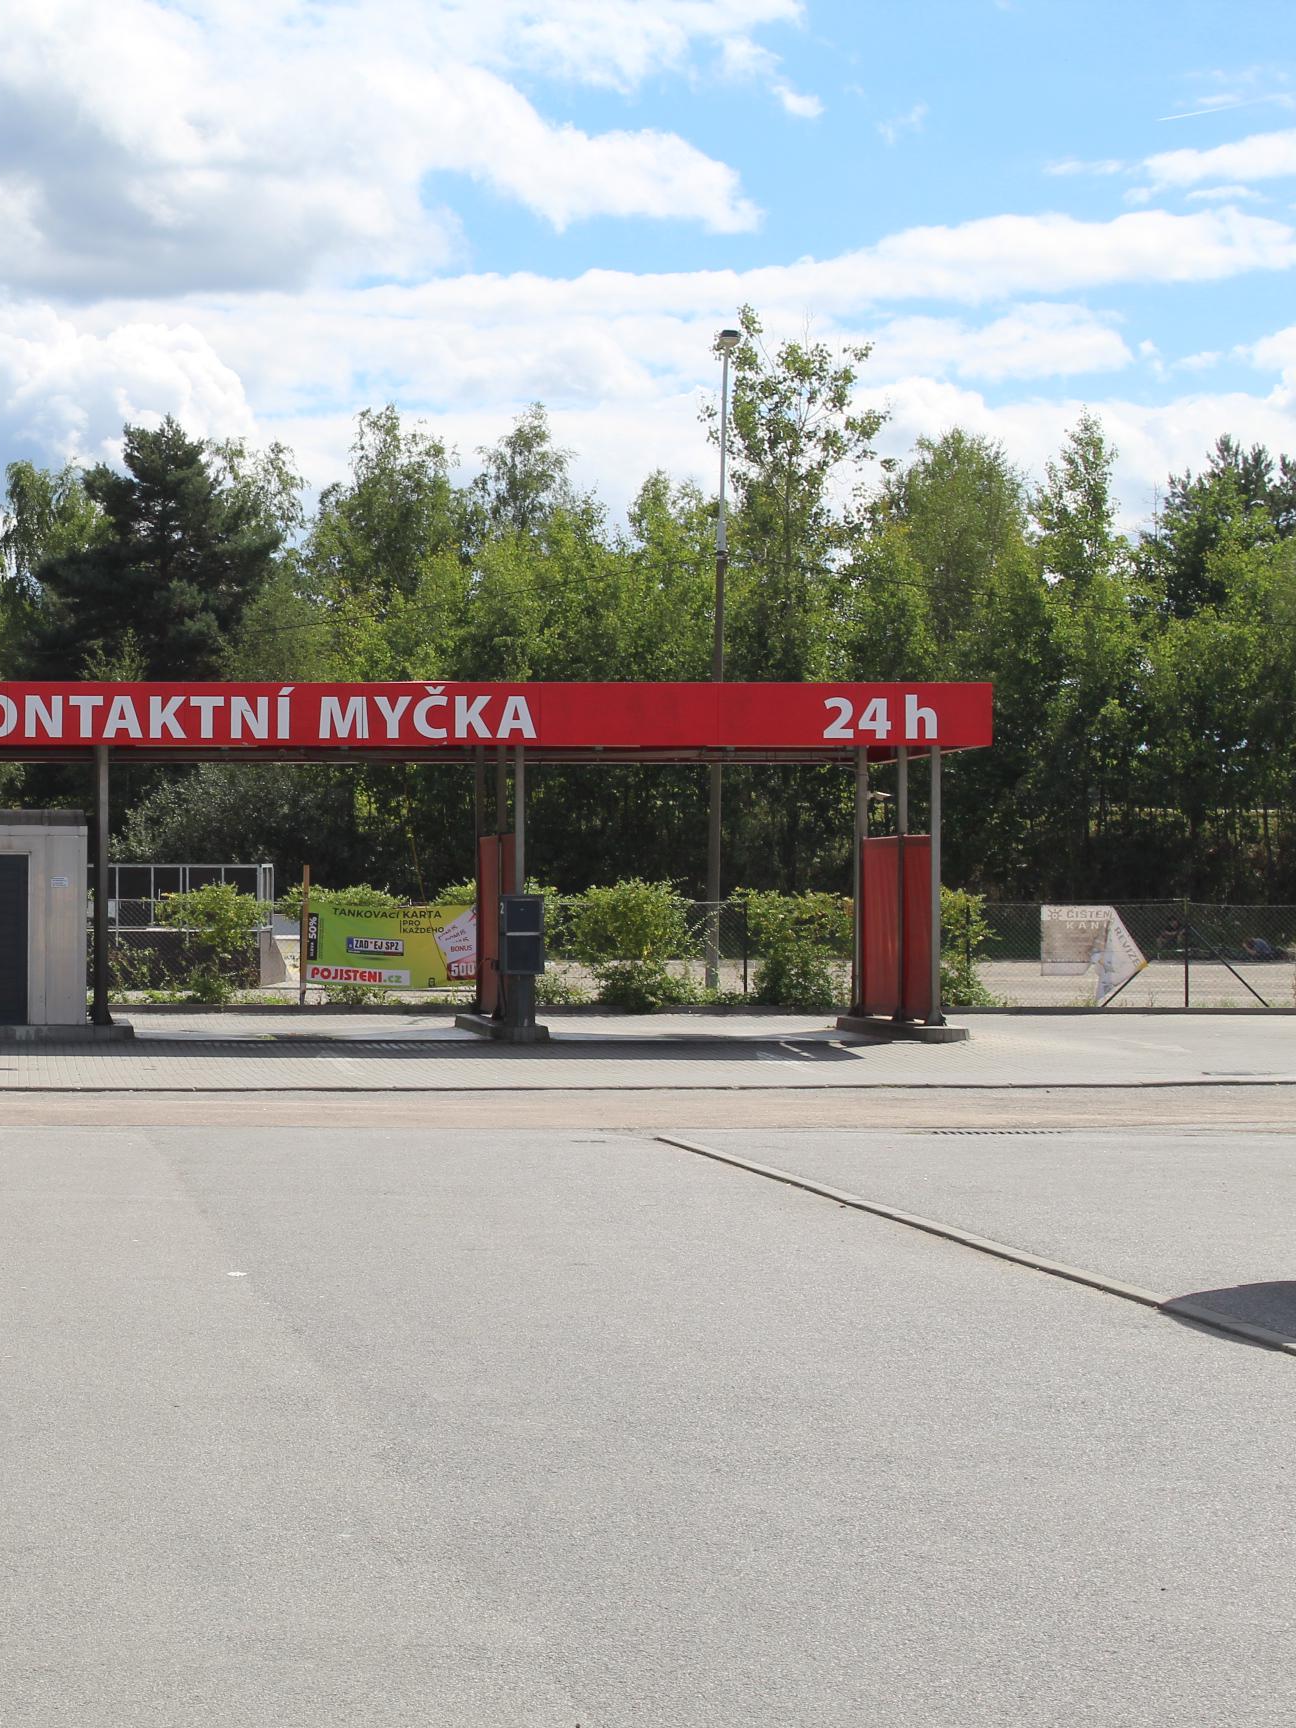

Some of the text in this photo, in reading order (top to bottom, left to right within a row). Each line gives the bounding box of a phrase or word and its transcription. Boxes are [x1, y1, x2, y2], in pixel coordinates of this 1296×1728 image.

[317, 685, 538, 739] MYČKA
[823, 694, 938, 739] 24 h
[332, 907, 442, 919] TANKOVACÍ KARTA
[308, 916, 318, 940] 50%
[402, 926, 445, 934] KAŽDÉHO
[384, 941, 399, 951] SPZ
[450, 944, 473, 953] BONUS
